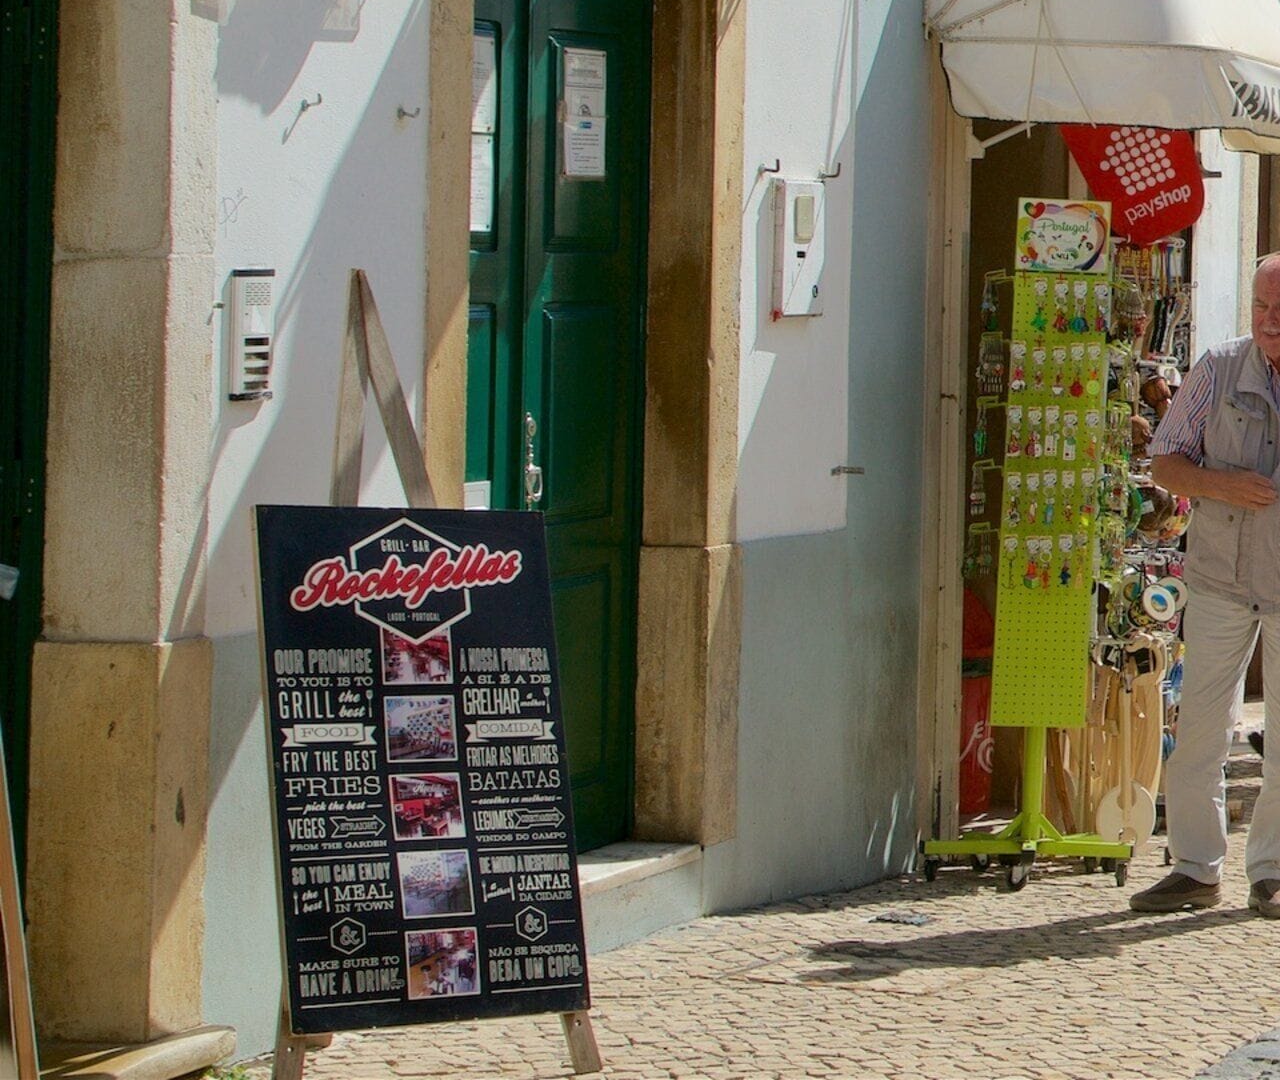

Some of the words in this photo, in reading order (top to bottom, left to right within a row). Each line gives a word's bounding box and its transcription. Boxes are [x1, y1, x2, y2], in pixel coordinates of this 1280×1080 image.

[1123, 183, 1192, 226] payshop
[290, 543, 522, 612] Rockefellas
[274, 649, 305, 675] OUR
[307, 648, 373, 674] PROMISE
[460, 647, 467, 672] A
[277, 677, 297, 687] TO
[337, 677, 351, 686] IS
[353, 676, 374, 686] TO
[461, 675, 475, 685] A
[514, 674, 527, 684] A
[529, 674, 552, 684] DE
[278, 690, 335, 719] GRILL
[338, 689, 361, 703] the
[338, 705, 366, 718] best
[462, 687, 521, 716] GRELHAR
[300, 727, 360, 738] FOOD
[479, 722, 541, 733] COMIDA
[283, 751, 308, 773] FRY
[314, 750, 340, 772] THE
[344, 750, 378, 771] BEST
[466, 746, 498, 767] FRITAR
[500, 745, 512, 766] AS
[512, 744, 560, 766] MELHORES
[284, 775, 382, 798] FRIES
[468, 769, 561, 791] BATATAS
[302, 801, 327, 815] pick
[328, 801, 345, 811] the
[346, 800, 366, 810] best
[287, 817, 327, 840] VEGES
[472, 809, 514, 831] LEGUMES
[289, 842, 319, 851] FROM
[321, 841, 343, 850] THE
[344, 840, 388, 849] GARDEN
[475, 833, 513, 842] VINDOS
[515, 832, 529, 841] DO
[531, 831, 567, 840] CAMPO
[291, 866, 307, 885] SO
[308, 865, 331, 884] YOU
[333, 863, 356, 882] CAN
[358, 862, 391, 881] ENJOY
[517, 873, 572, 891] JANTAR
[301, 889, 319, 901] the
[333, 882, 394, 902] MEAL
[519, 892, 534, 902] DA
[535, 890, 573, 901] CIDADE
[303, 900, 323, 913] best
[334, 903, 351, 914] IN
[354, 900, 395, 912] TOWN
[488, 946, 512, 958] NÃO
[514, 946, 529, 956] SE
[299, 960, 340, 972] MAKE
[343, 956, 379, 969] SURE
[381, 955, 400, 966] TO
[524, 956, 545, 980] UM
[300, 972, 337, 998] HAVE
[342, 971, 352, 994] A
[356, 967, 400, 994] DRINK
